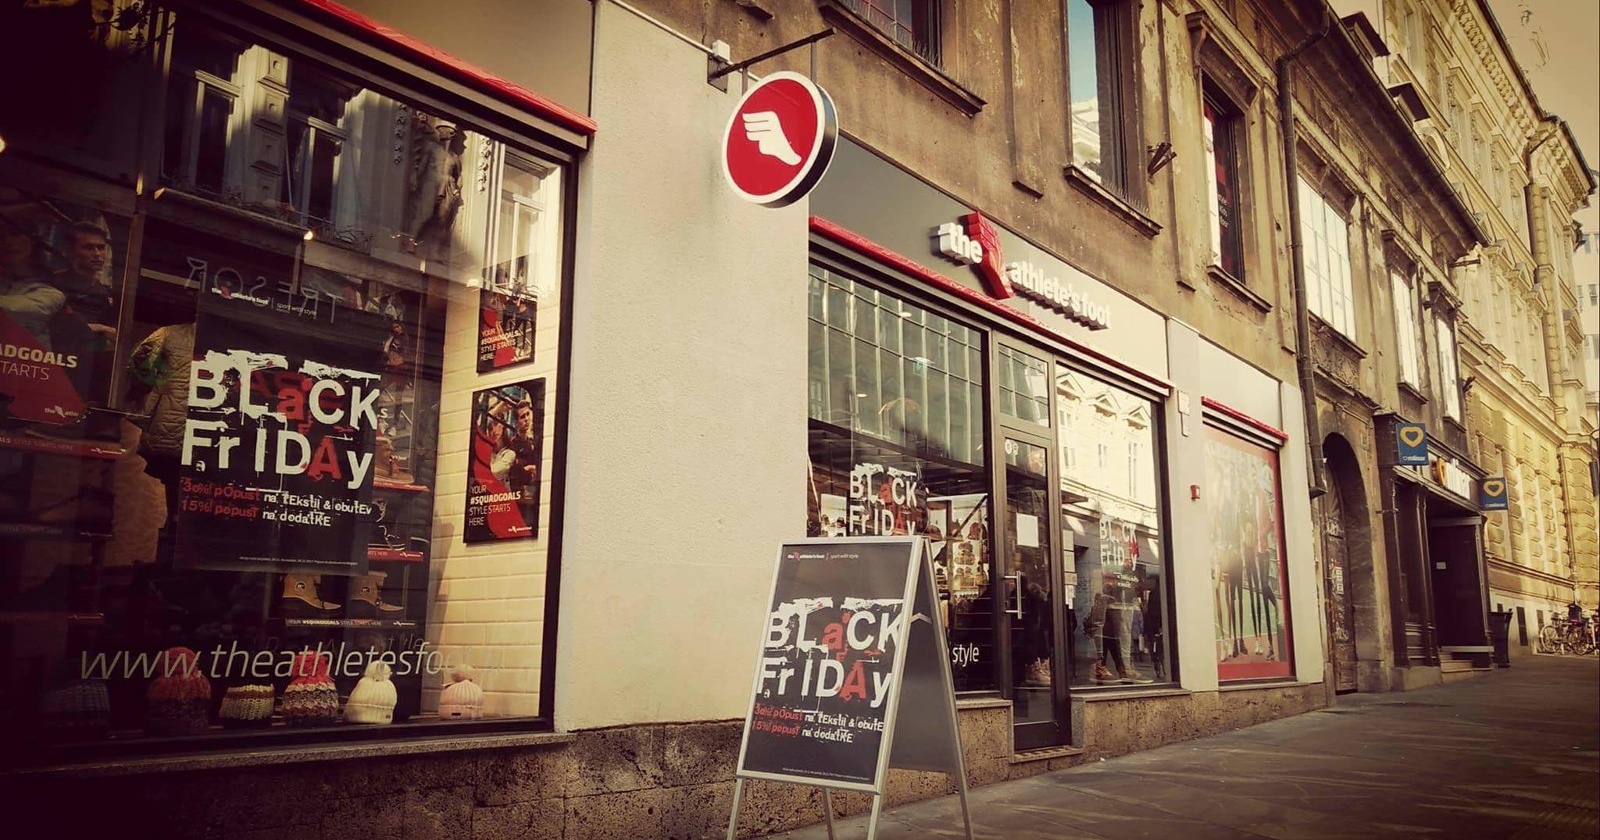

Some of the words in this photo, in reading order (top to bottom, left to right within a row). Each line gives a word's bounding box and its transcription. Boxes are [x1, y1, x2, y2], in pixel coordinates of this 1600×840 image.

[939, 222, 983, 264] the
[1010, 260, 1082, 312] athlete's
[1081, 292, 1112, 328] foot
[482, 328, 495, 337] YOUR
[470, 484, 486, 494] YOUR
[470, 490, 520, 505] #SQUADGOALS
[323, 501, 331, 510] &
[469, 505, 487, 516] STYLE
[487, 503, 510, 514] STARTS
[468, 517, 484, 526] HERE
[952, 642, 980, 667] style
[857, 716, 888, 732] obutE
